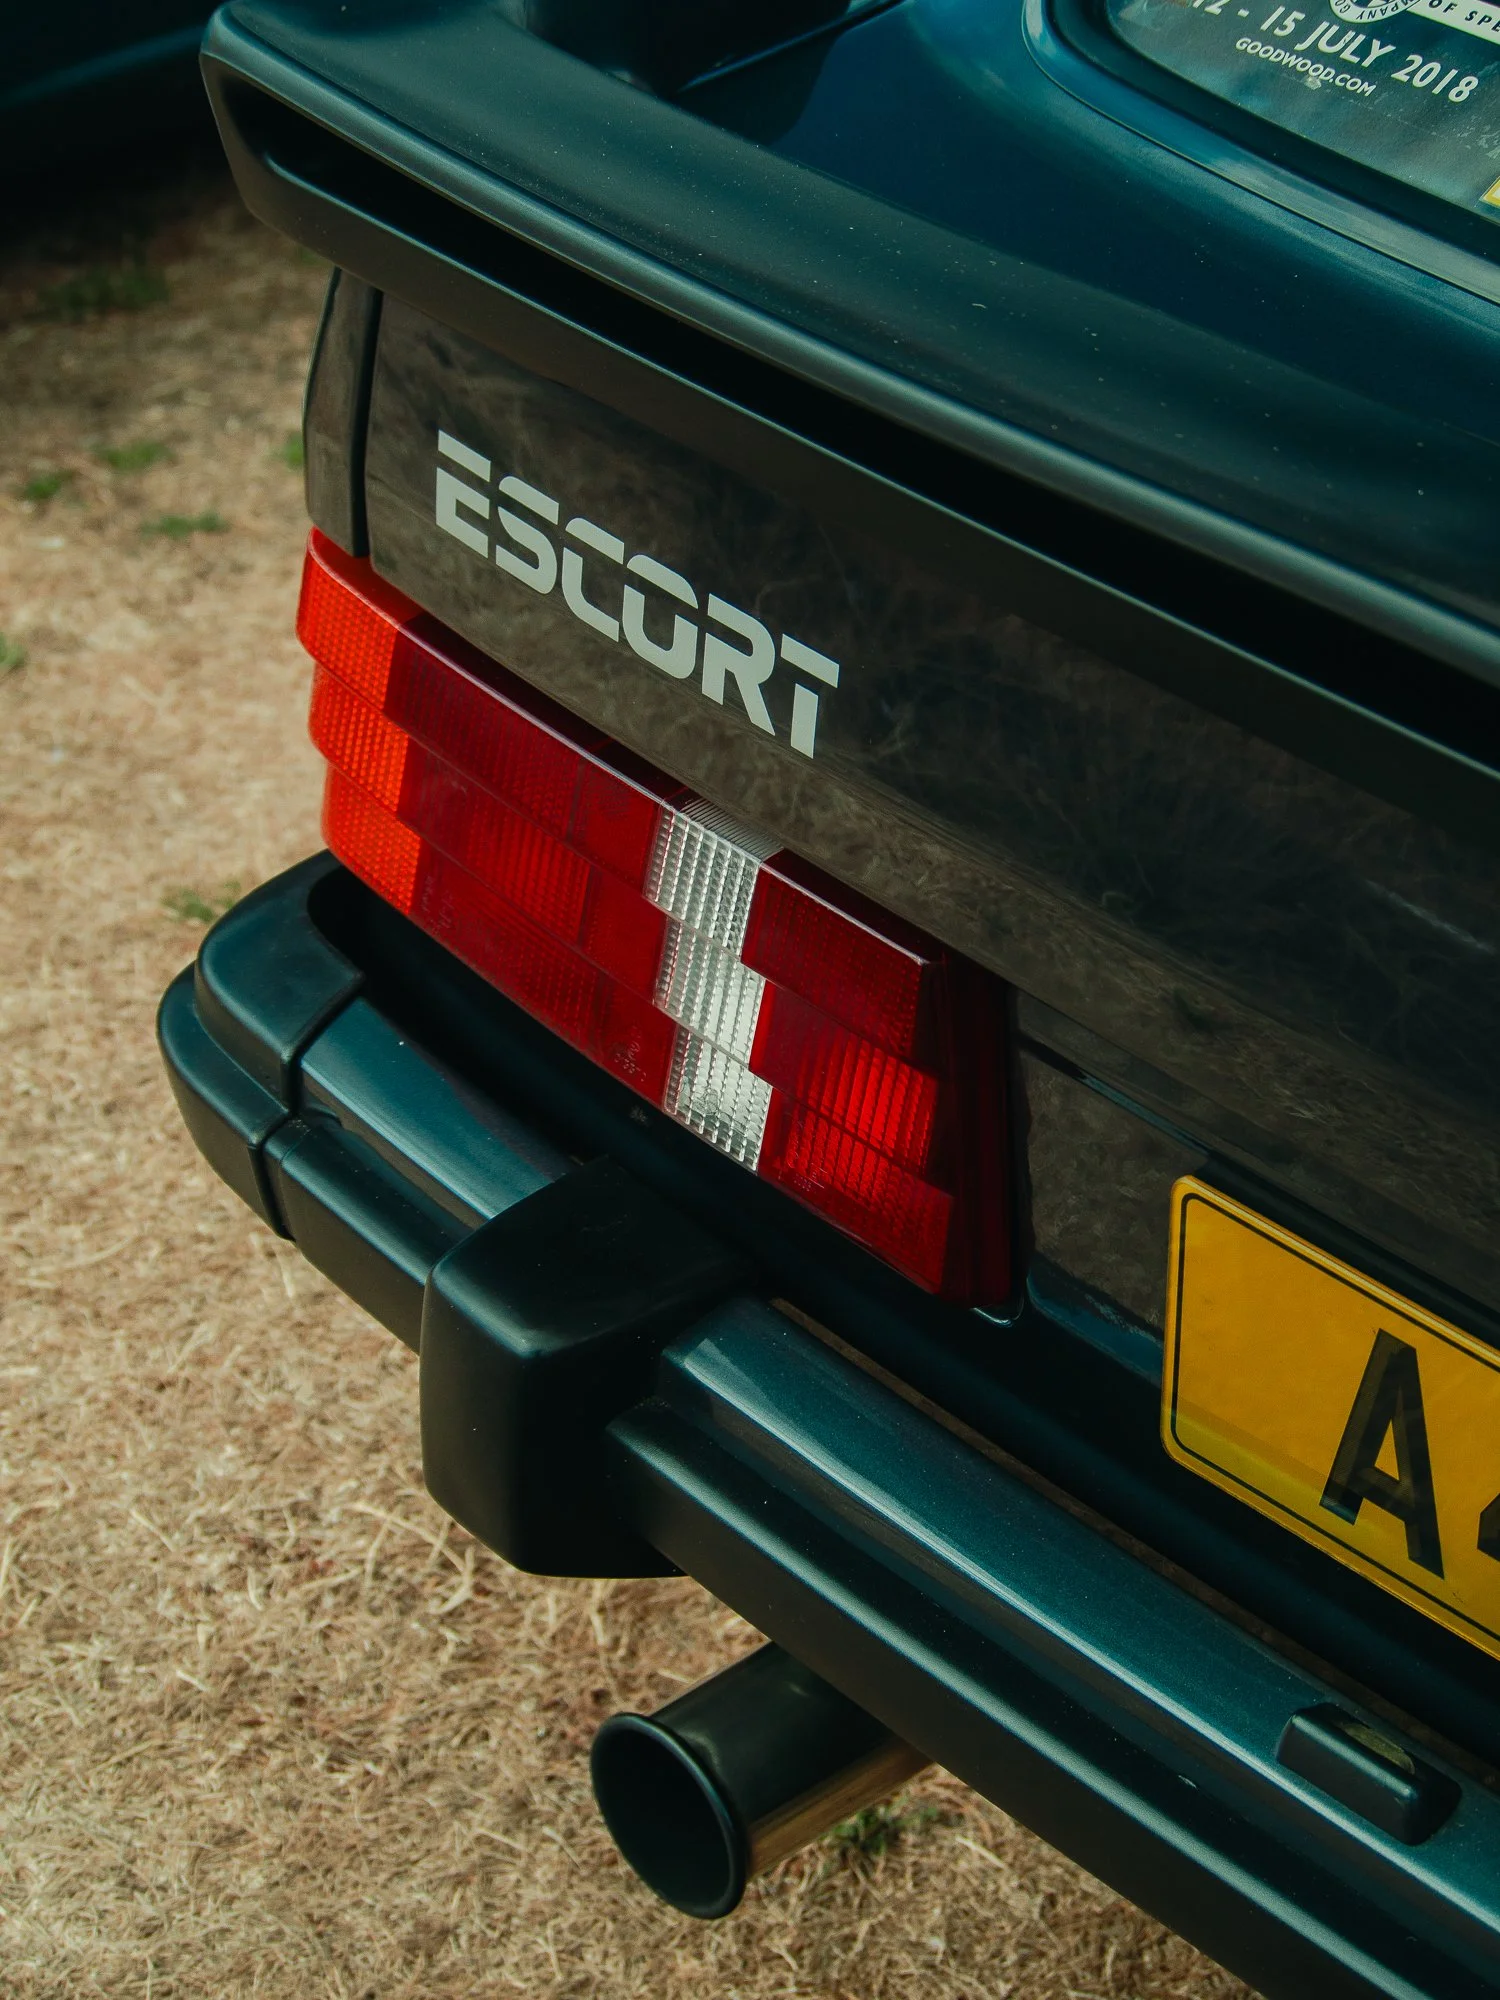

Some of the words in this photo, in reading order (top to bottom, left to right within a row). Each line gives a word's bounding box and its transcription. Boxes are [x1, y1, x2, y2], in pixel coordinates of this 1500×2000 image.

[1428, 0, 1458, 13] OF
[1235, 37, 1377, 97] GOODWOOD.COM
[1260, 5, 1306, 37] 15
[1293, 21, 1396, 68] JULY
[1391, 54, 1479, 102] 2018
[436, 429, 840, 759] ESCORT
